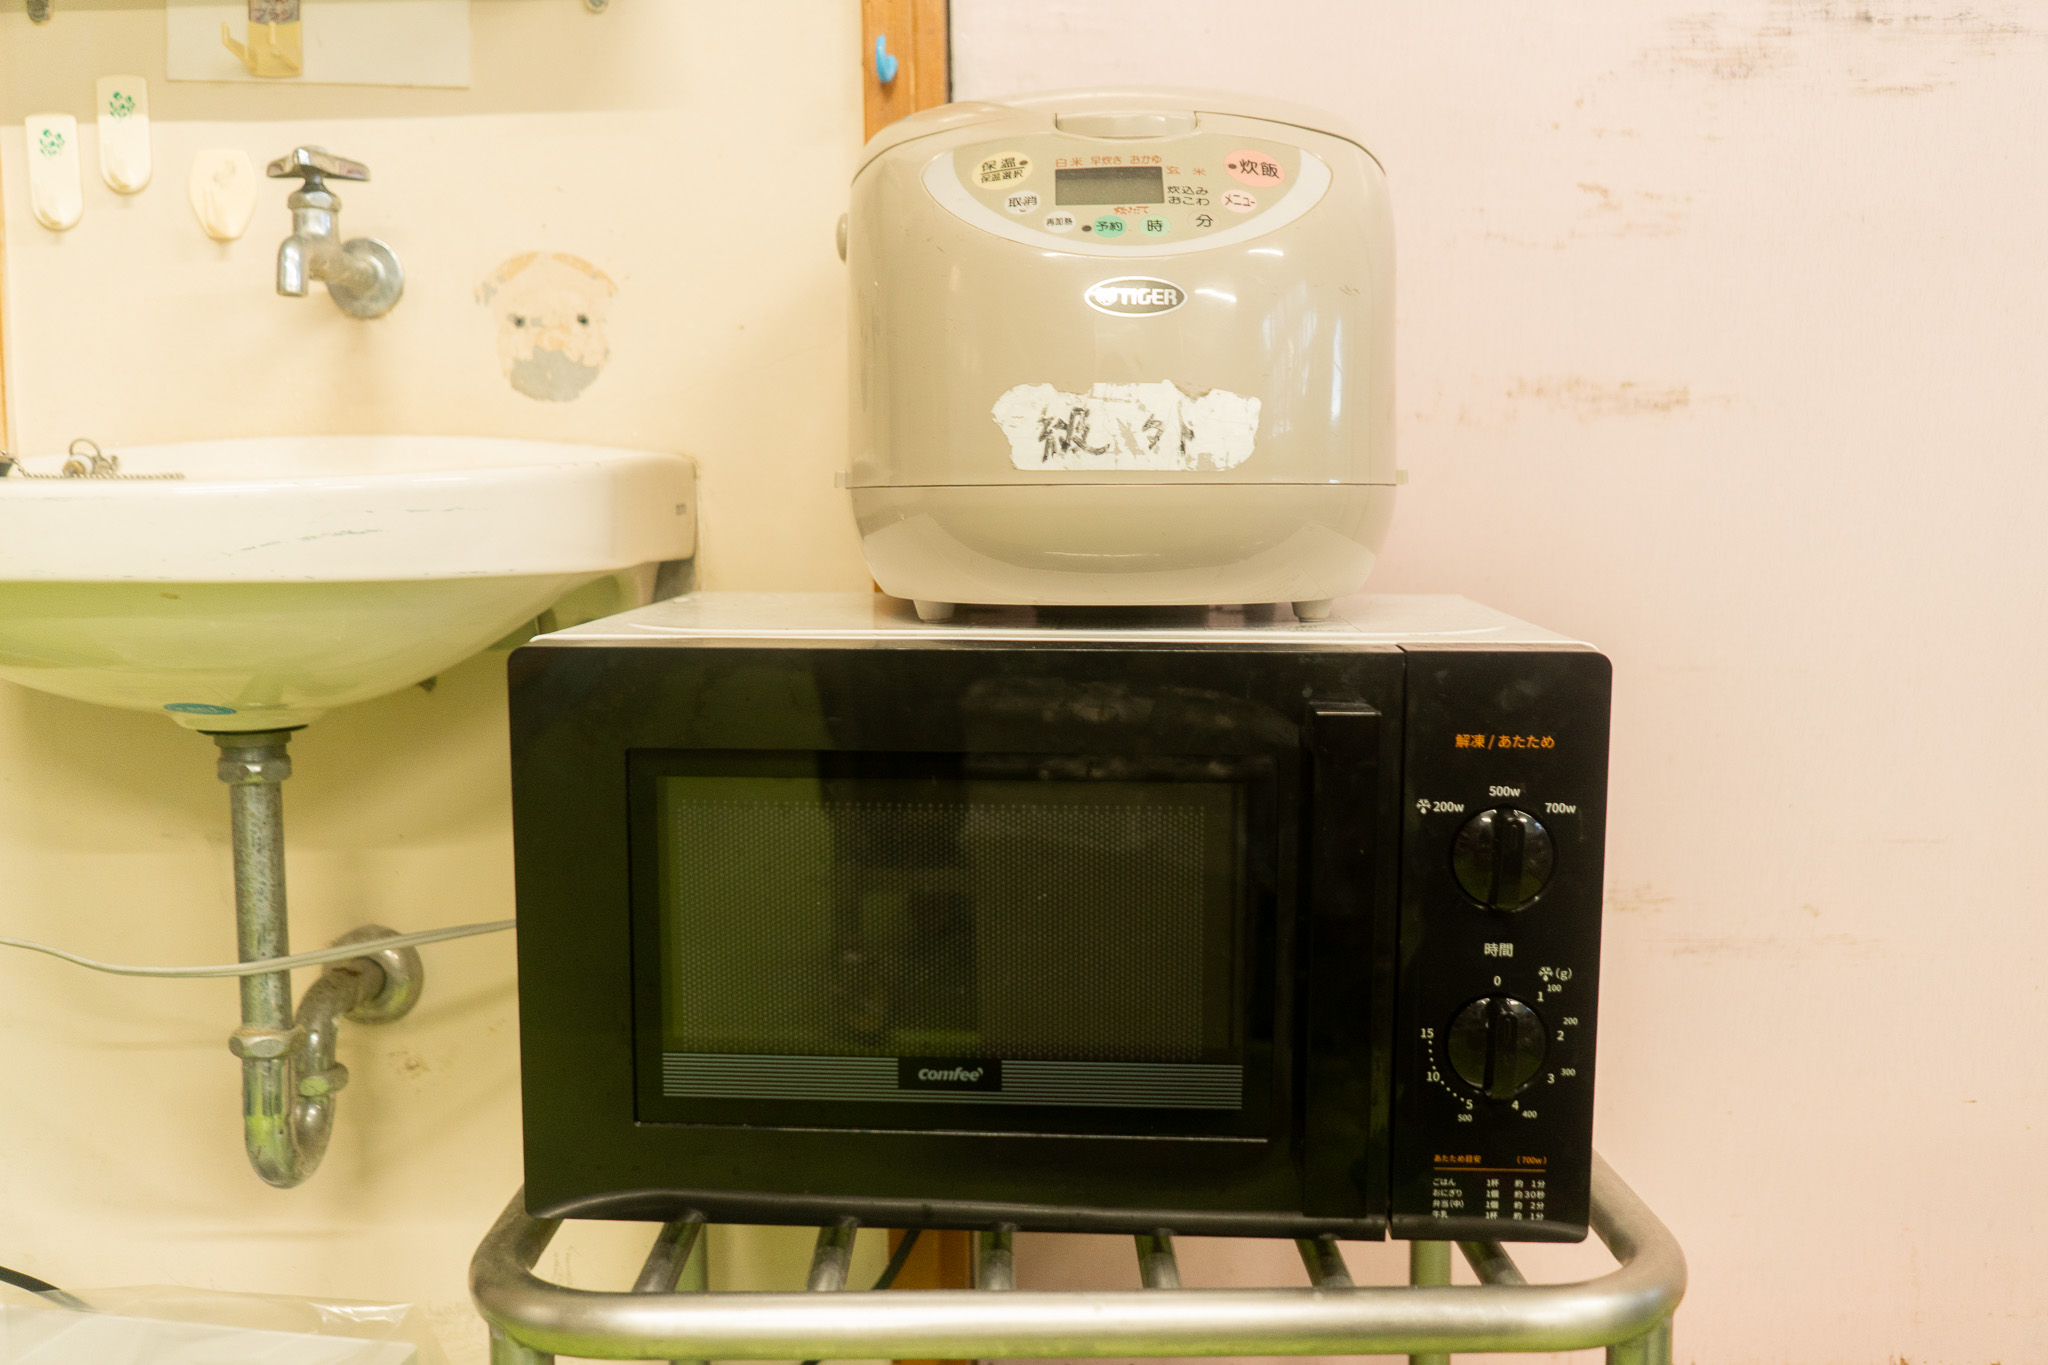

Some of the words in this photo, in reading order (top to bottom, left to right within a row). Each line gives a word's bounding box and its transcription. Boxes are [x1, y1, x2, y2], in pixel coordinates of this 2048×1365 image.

[982, 157, 1016, 171] 保温
[1239, 158, 1280, 179] 炊飯
[981, 170, 1024, 183] 保温選択
[1168, 186, 1209, 195] 炊込み
[1168, 196, 1210, 206] おこわ
[1225, 194, 1256, 207] メニュー
[1046, 217, 1073, 226] 再加熱
[1096, 221, 1123, 232] 予約
[1147, 220, 1163, 232] 時
[1196, 214, 1213, 228] 分
[1117, 287, 1178, 306] TIGER
[1488, 786, 1521, 797] 500w
[1433, 801, 1465, 813] 200w
[1545, 802, 1577, 814] 700w
[1484, 943, 1514, 957] 時間
[1555, 967, 1572, 981] (g)
[1493, 975, 1502, 986] 0
[1547, 984, 1562, 992] 100
[1537, 991, 1544, 1002] 1
[1563, 1017, 1578, 1025] 200
[1420, 1028, 1434, 1039] 15
[1556, 1030, 1565, 1041] 2
[1426, 1072, 1440, 1082] 10
[1560, 1068, 1576, 1077] 300
[1547, 1073, 1555, 1084] 3
[1466, 1099, 1474, 1110] 5
[1511, 1100, 1519, 1110] 4
[1458, 1114, 1473, 1122] 500
[1522, 1110, 1538, 1119] 400
[1434, 1154, 1482, 1164] あたため目安
[1433, 1178, 1456, 1187] ごはん
[1433, 1189, 1463, 1198] おにぎり
